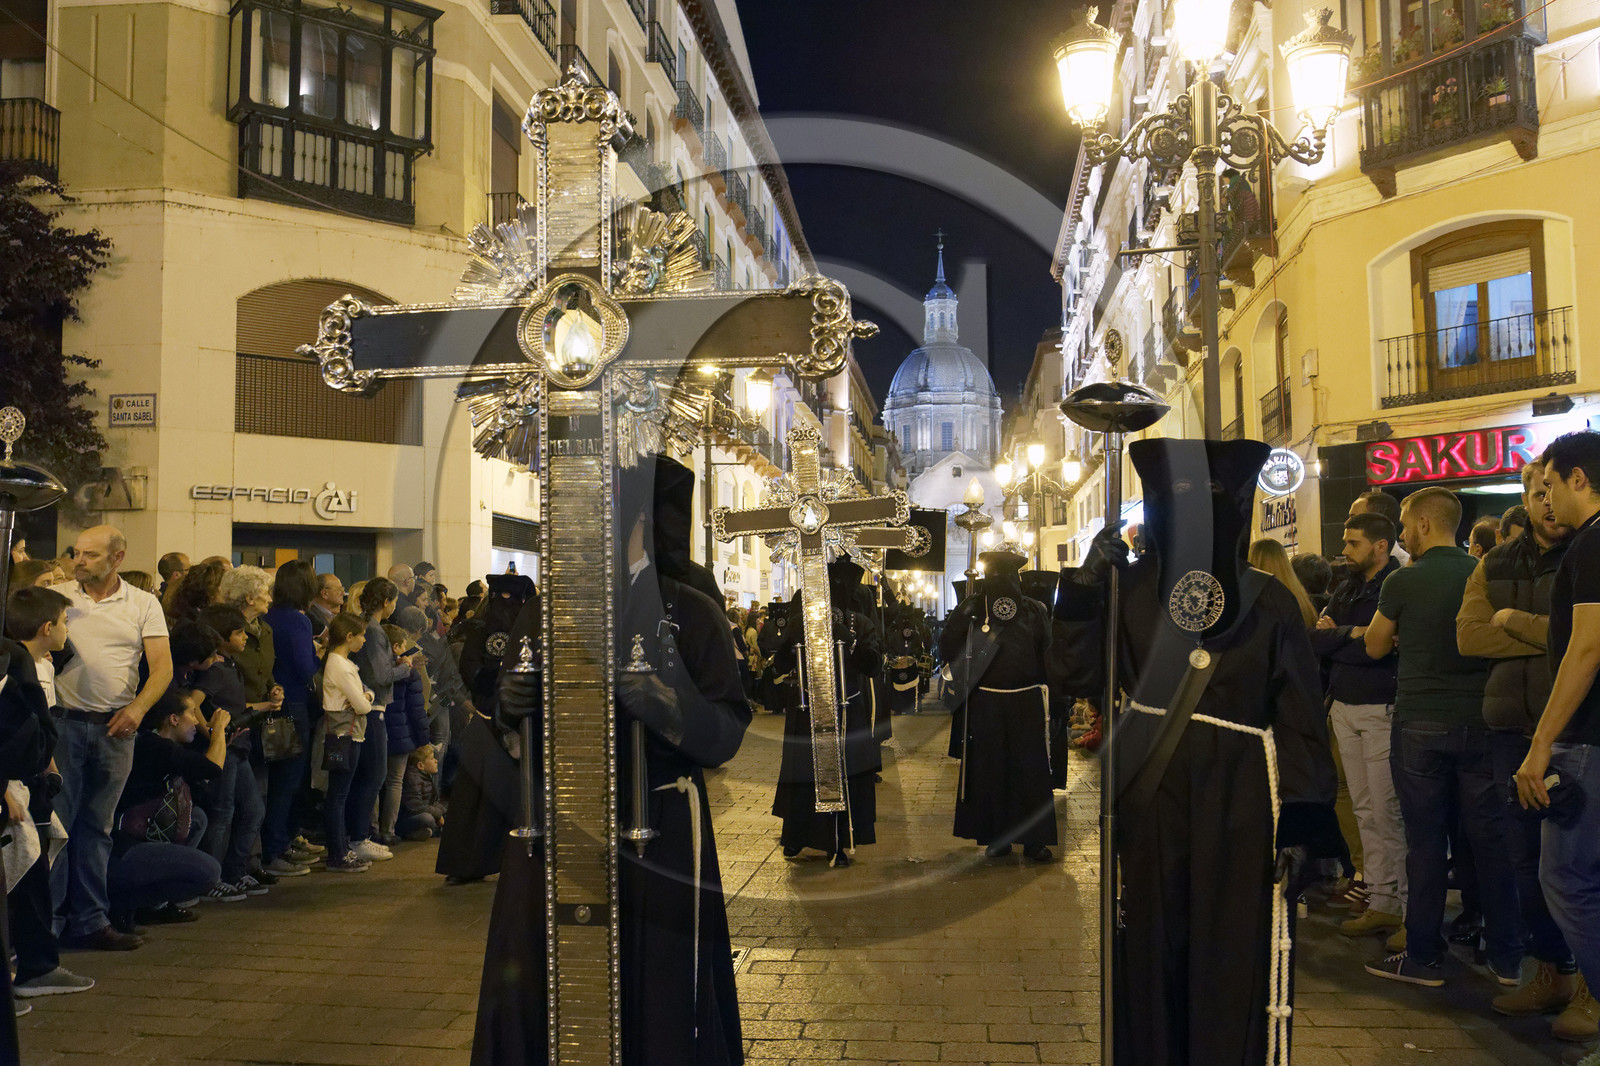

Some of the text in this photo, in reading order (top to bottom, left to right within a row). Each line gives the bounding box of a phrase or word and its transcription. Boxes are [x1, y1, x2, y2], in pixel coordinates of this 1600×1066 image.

[112, 412, 153, 421] SANTA ISABEL
[1366, 427, 1538, 482] SAKUR
[191, 484, 311, 503] ESPACIO
